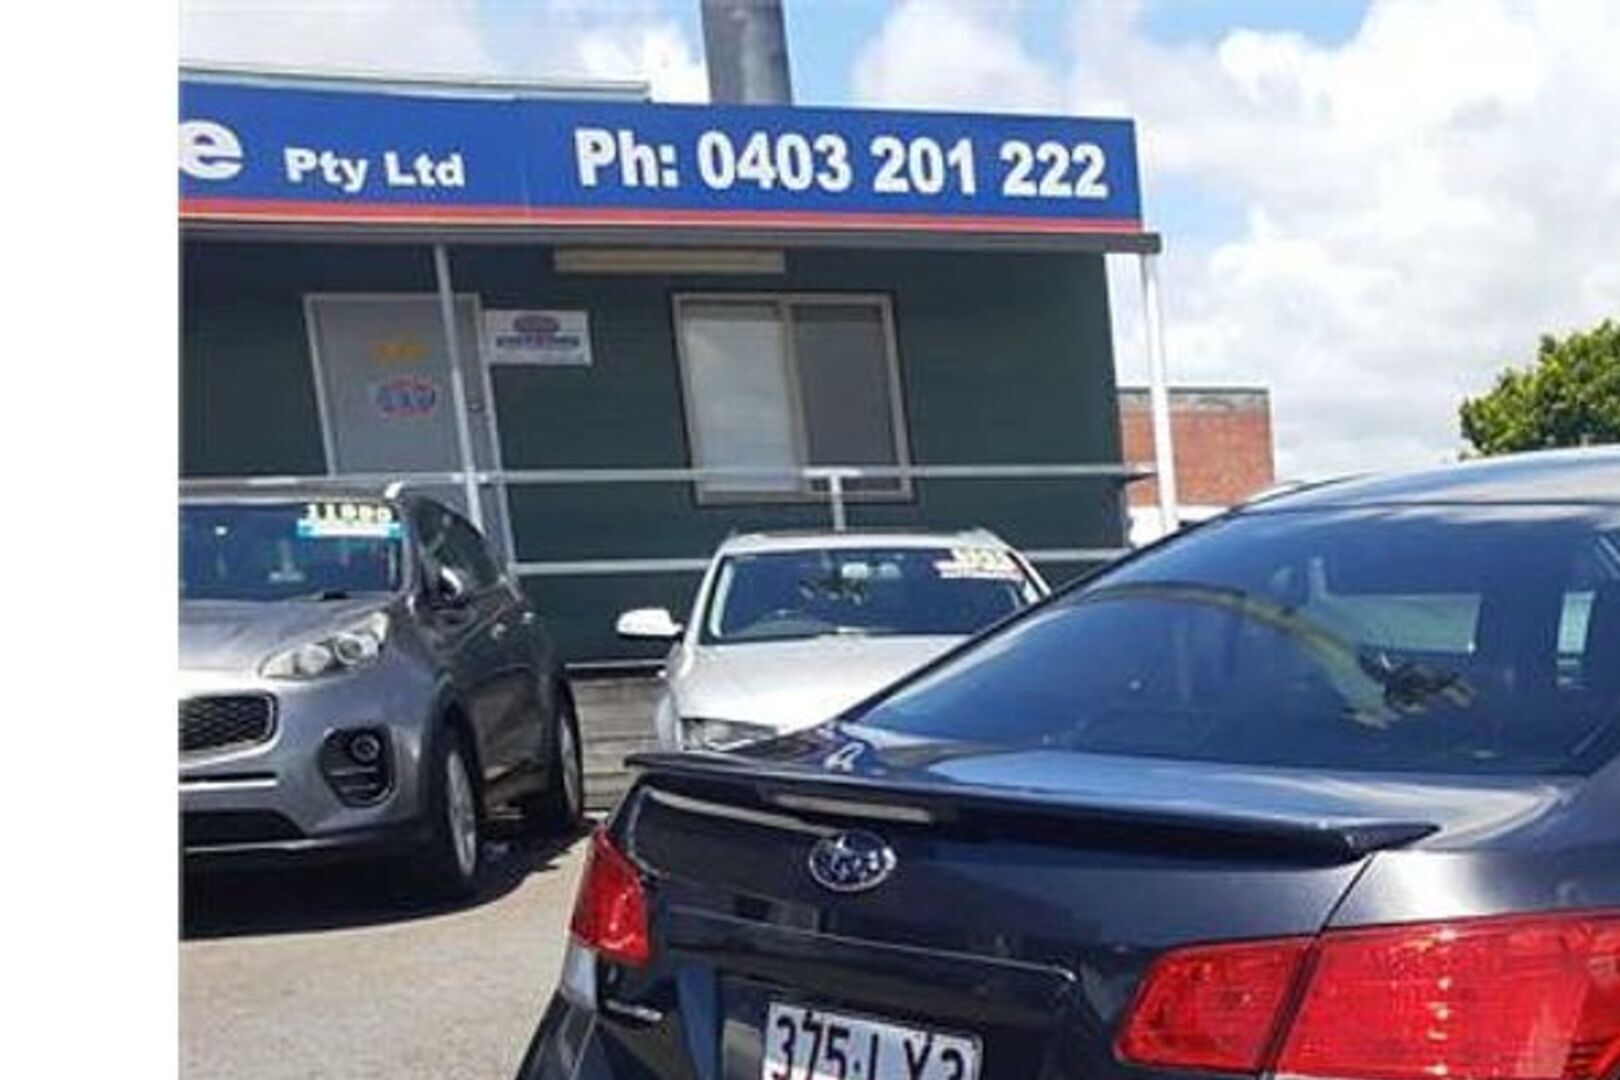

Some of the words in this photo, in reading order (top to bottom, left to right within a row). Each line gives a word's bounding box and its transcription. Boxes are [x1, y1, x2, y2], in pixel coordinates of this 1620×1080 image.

[283, 147, 367, 191] Pty
[385, 151, 465, 188] Ltd
[574, 129, 678, 188] Ph:
[699, 130, 852, 191] 0403
[870, 137, 976, 195] 201
[1002, 141, 1109, 199] 222
